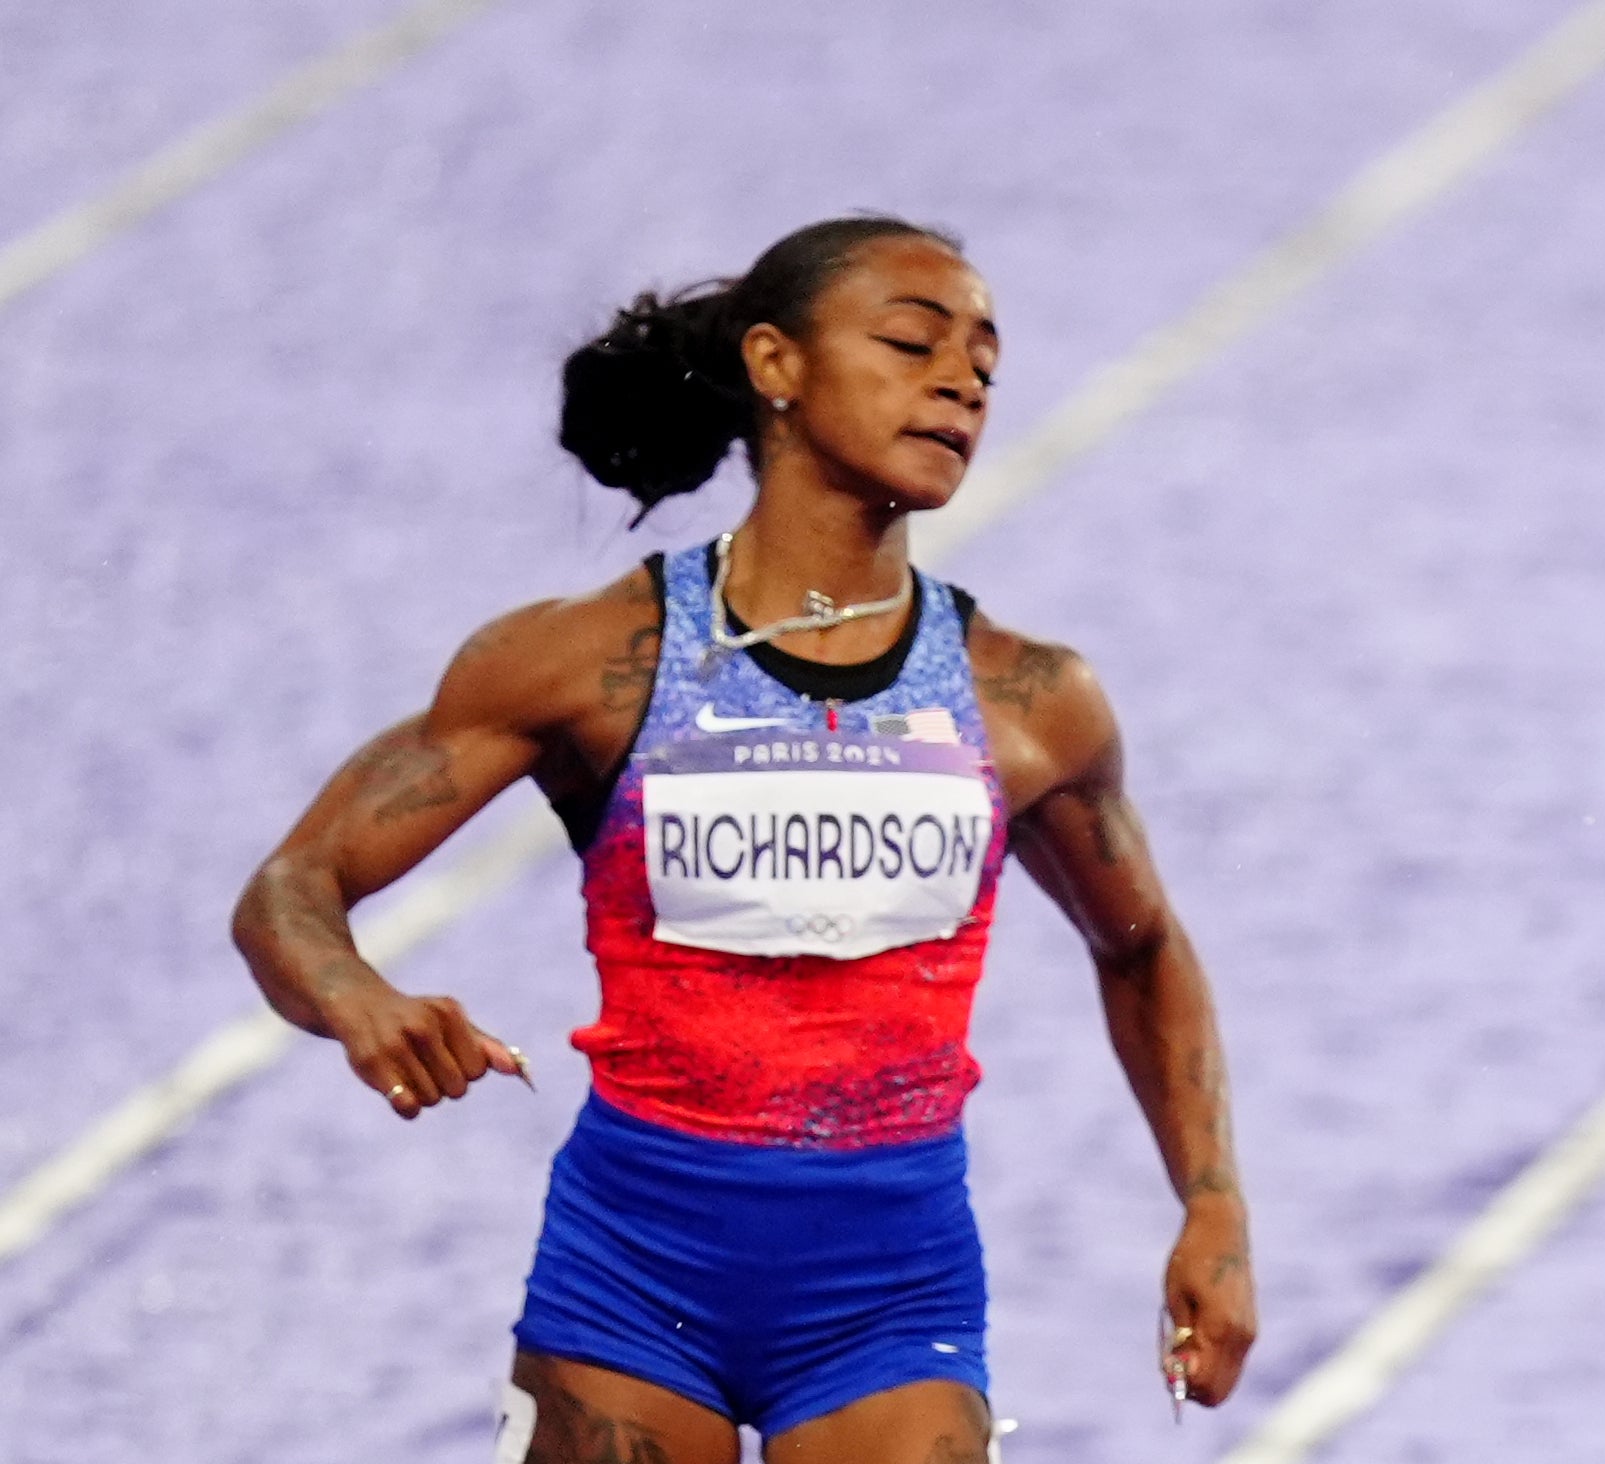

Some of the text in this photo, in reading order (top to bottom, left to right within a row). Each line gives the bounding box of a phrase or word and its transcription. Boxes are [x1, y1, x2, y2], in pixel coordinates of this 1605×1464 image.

[734, 742, 901, 766] PARIS 2024
[660, 813, 981, 879] RICHARDSON
